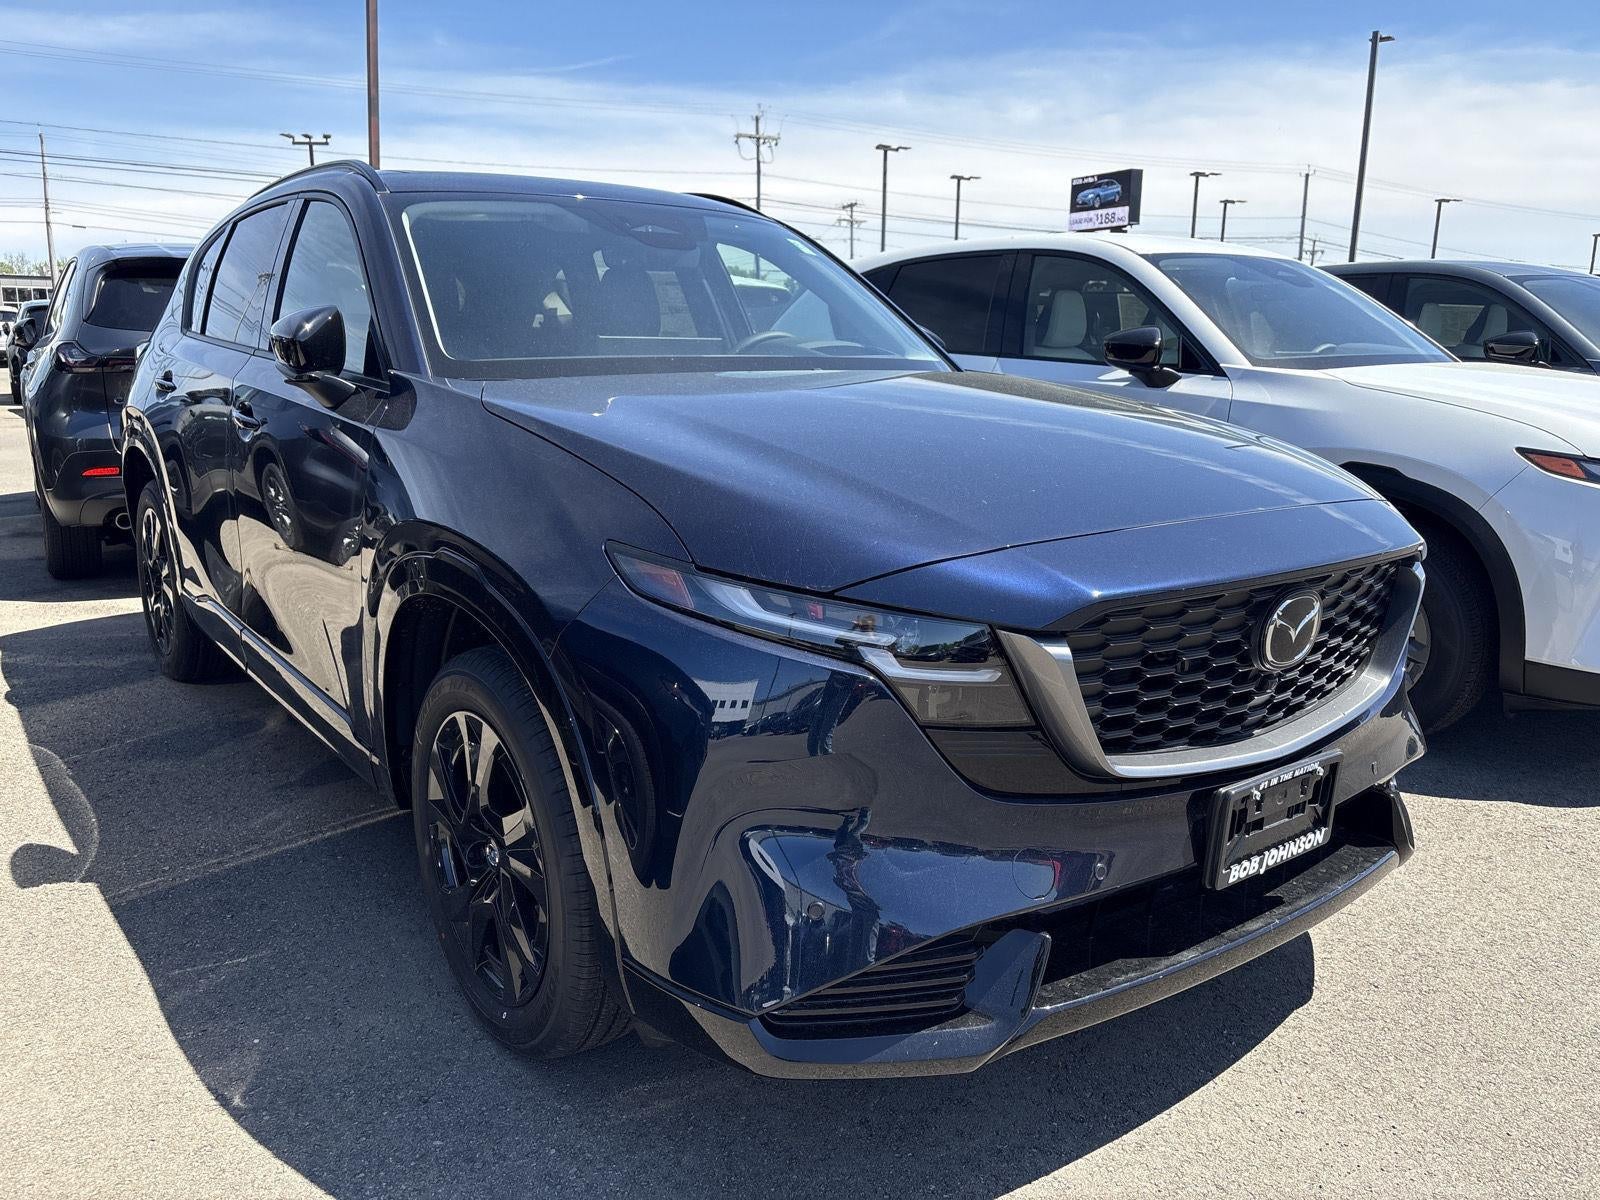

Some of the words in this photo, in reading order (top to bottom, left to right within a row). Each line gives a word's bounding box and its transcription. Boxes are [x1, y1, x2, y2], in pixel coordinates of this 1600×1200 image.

[1259, 781, 1269, 791] #1
[1270, 777, 1279, 787] IN
[1280, 771, 1294, 783] THE
[1294, 761, 1320, 778] NATION
[1224, 855, 1261, 884] BOB
[1259, 827, 1328, 875] JOHNSON
